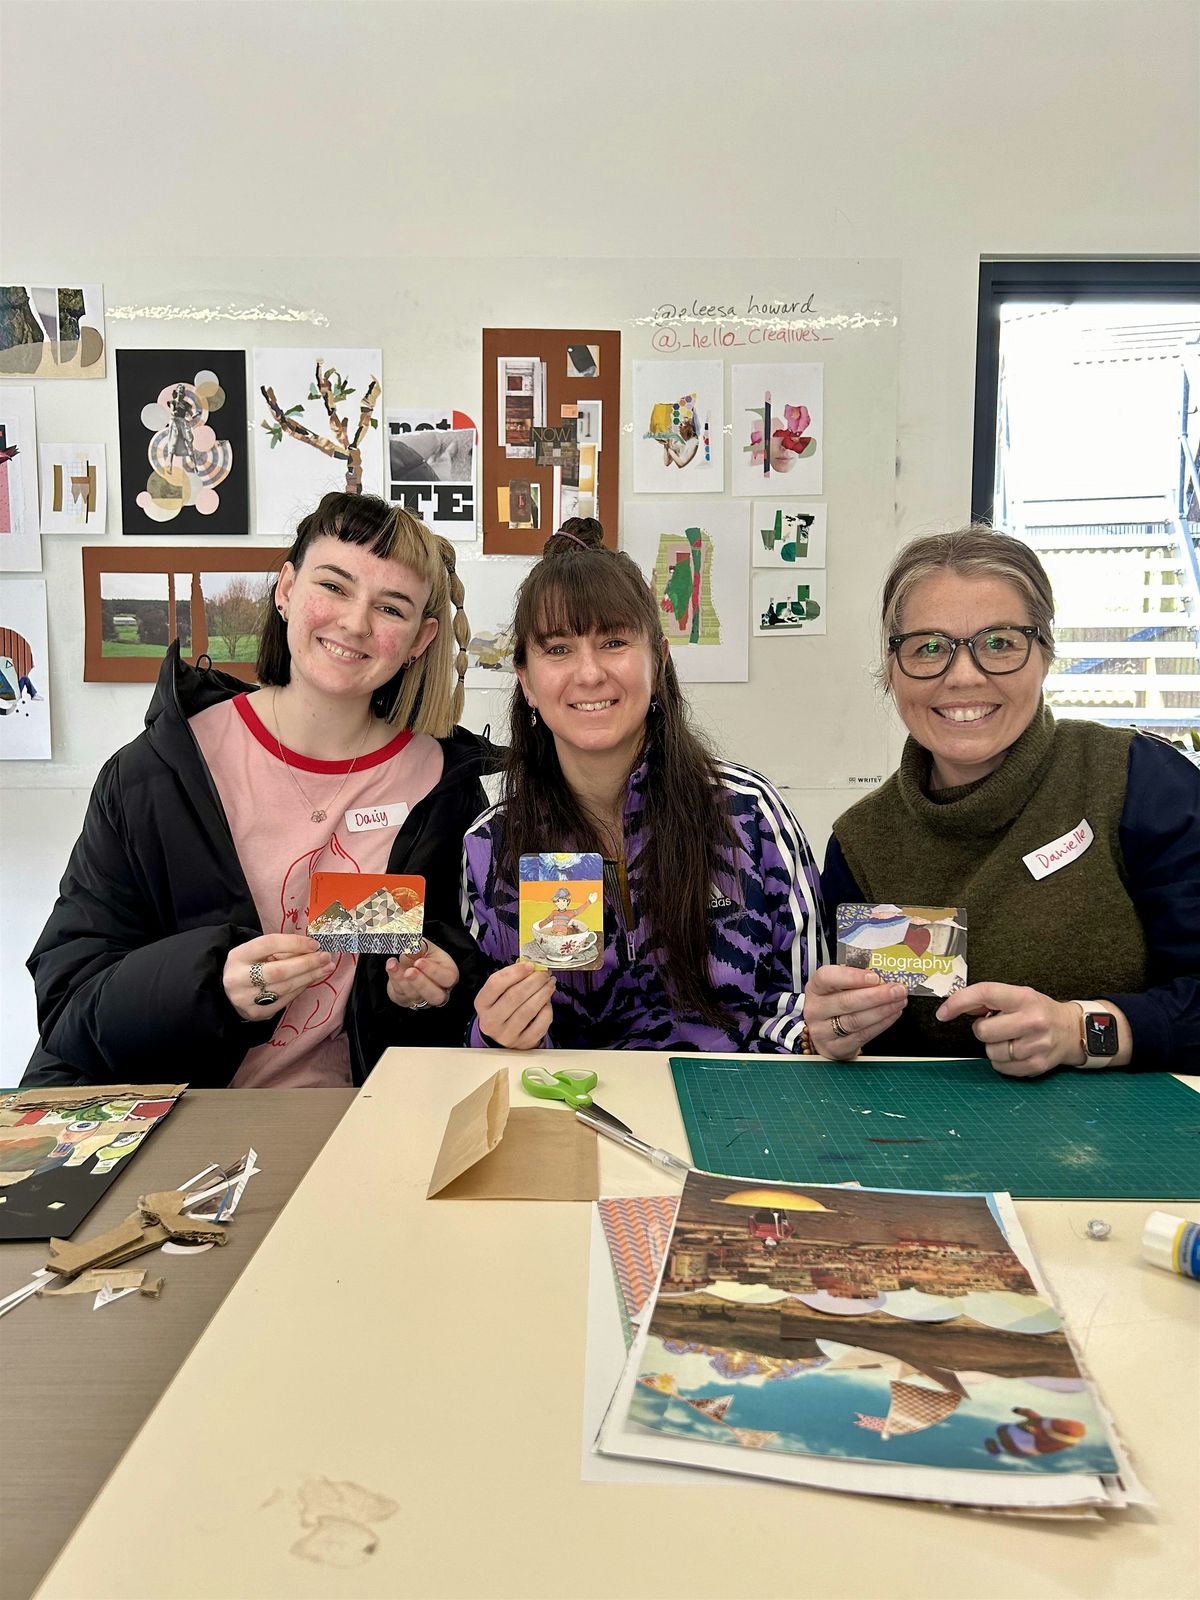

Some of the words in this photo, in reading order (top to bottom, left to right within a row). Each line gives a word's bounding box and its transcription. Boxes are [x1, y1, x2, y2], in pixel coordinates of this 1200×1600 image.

[391, 485, 473, 521] TE
[355, 810, 389, 826] Daisy
[1036, 829, 1086, 868] Danielle
[871, 953, 951, 973] Biography
